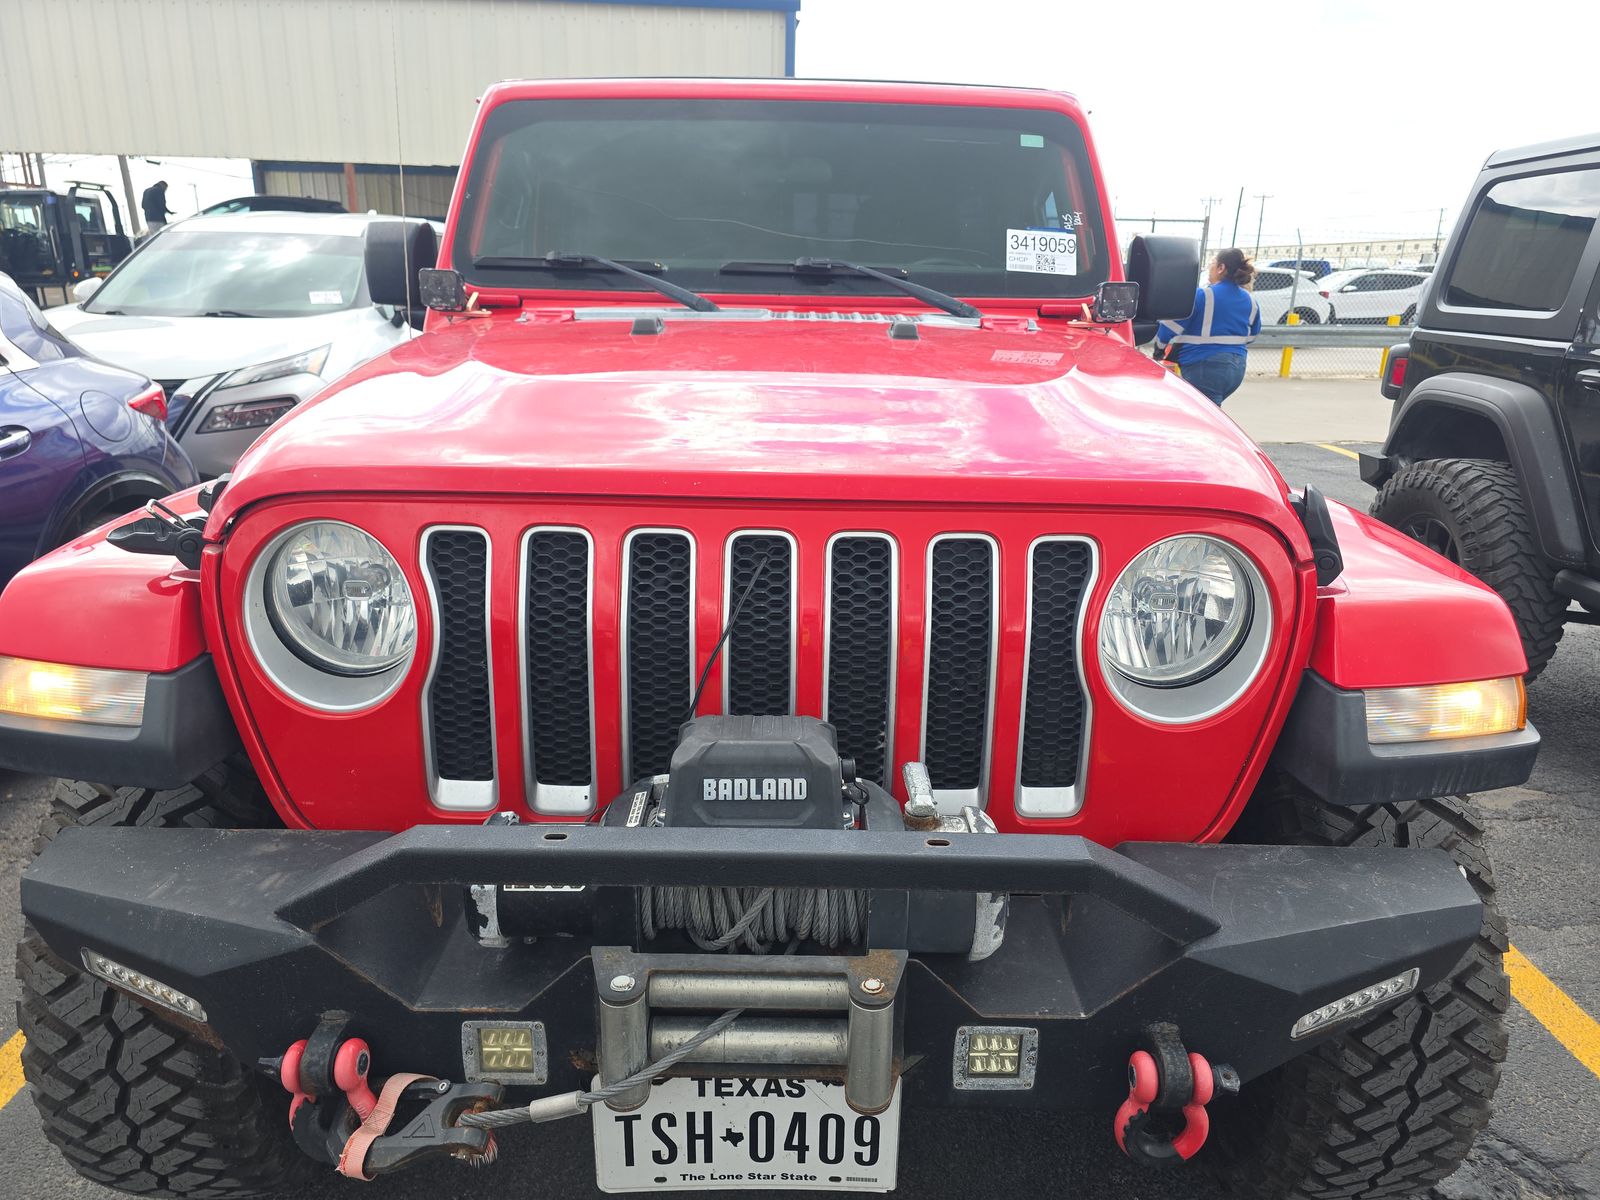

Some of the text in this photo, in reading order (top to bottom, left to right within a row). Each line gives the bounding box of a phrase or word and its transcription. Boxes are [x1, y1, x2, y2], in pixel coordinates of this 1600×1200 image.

[1010, 234, 1076, 254] 3419059
[703, 778, 807, 801] BADLAND
[690, 1077, 807, 1098] TEXAS
[680, 1172, 817, 1182] The Lone Star State
